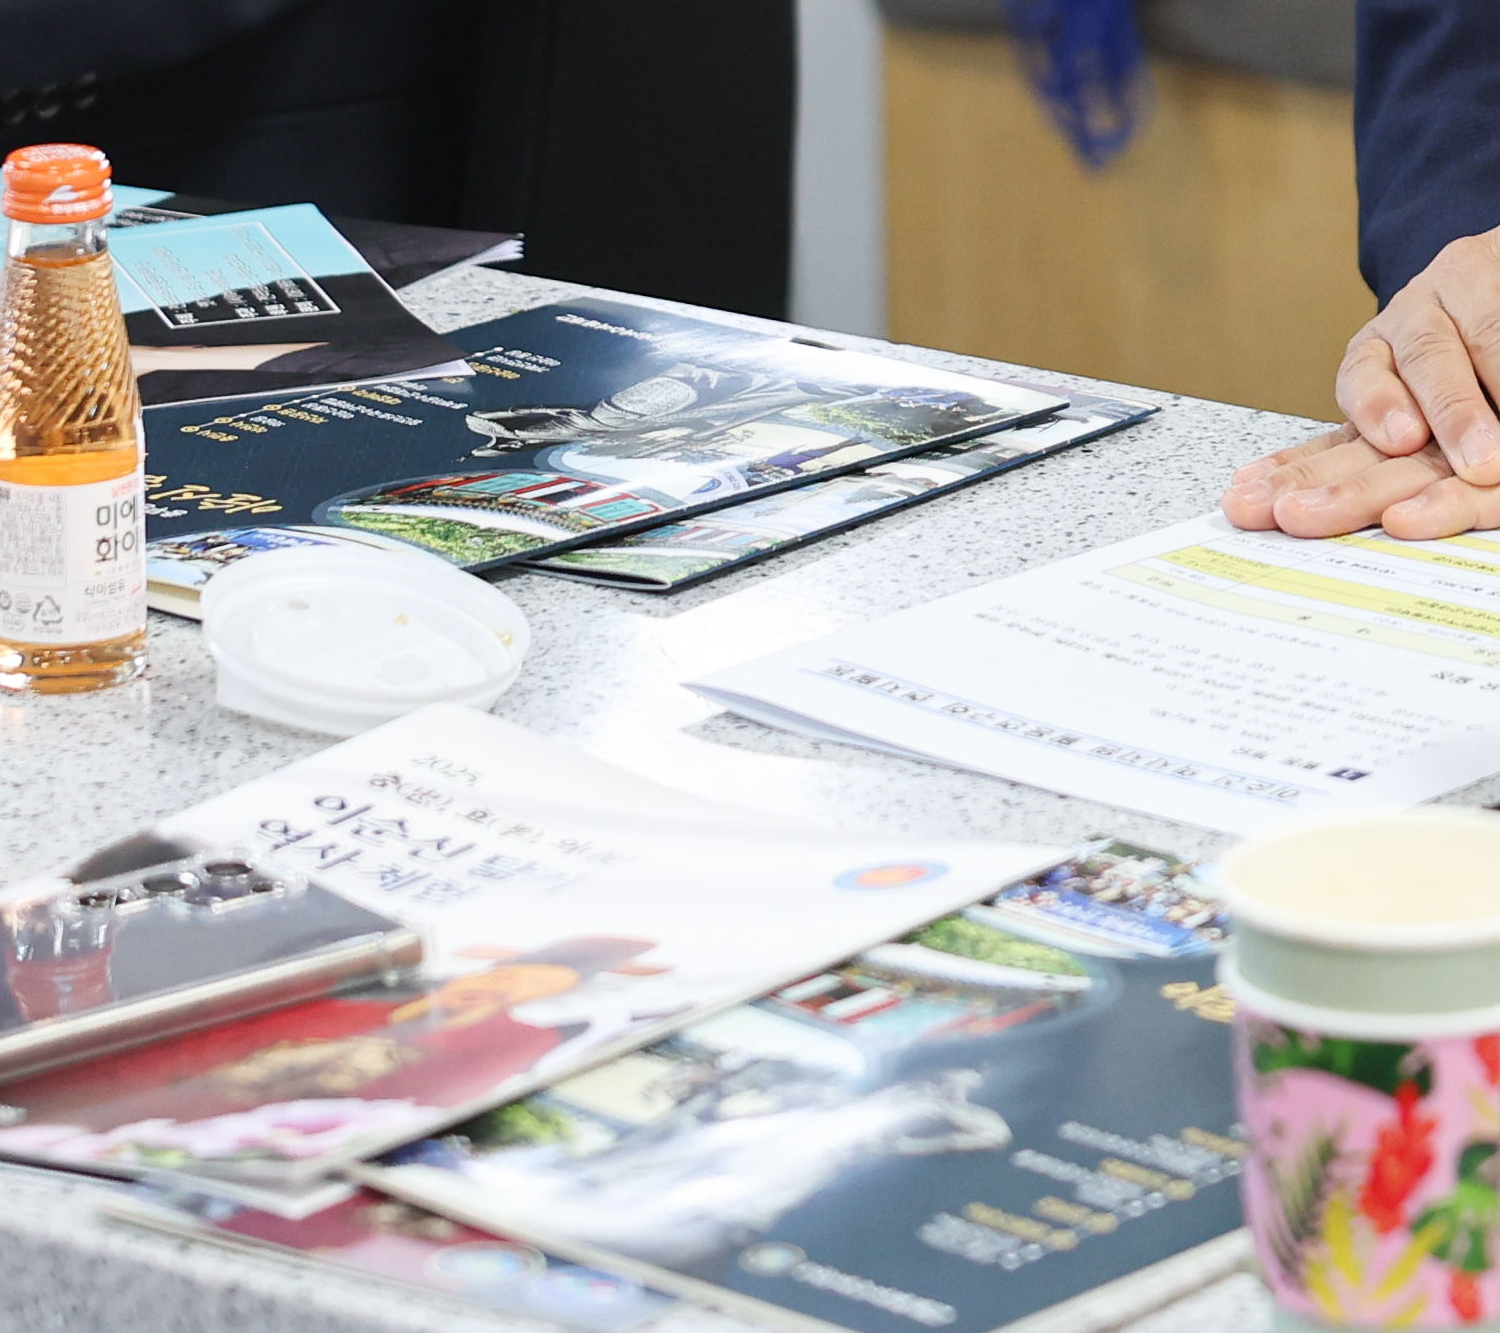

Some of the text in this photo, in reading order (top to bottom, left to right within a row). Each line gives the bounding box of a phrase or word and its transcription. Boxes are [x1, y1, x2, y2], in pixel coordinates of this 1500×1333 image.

[95, 525, 141, 562] 화이
[258, 818, 363, 871] 역사
[313, 794, 478, 862] 이순신
